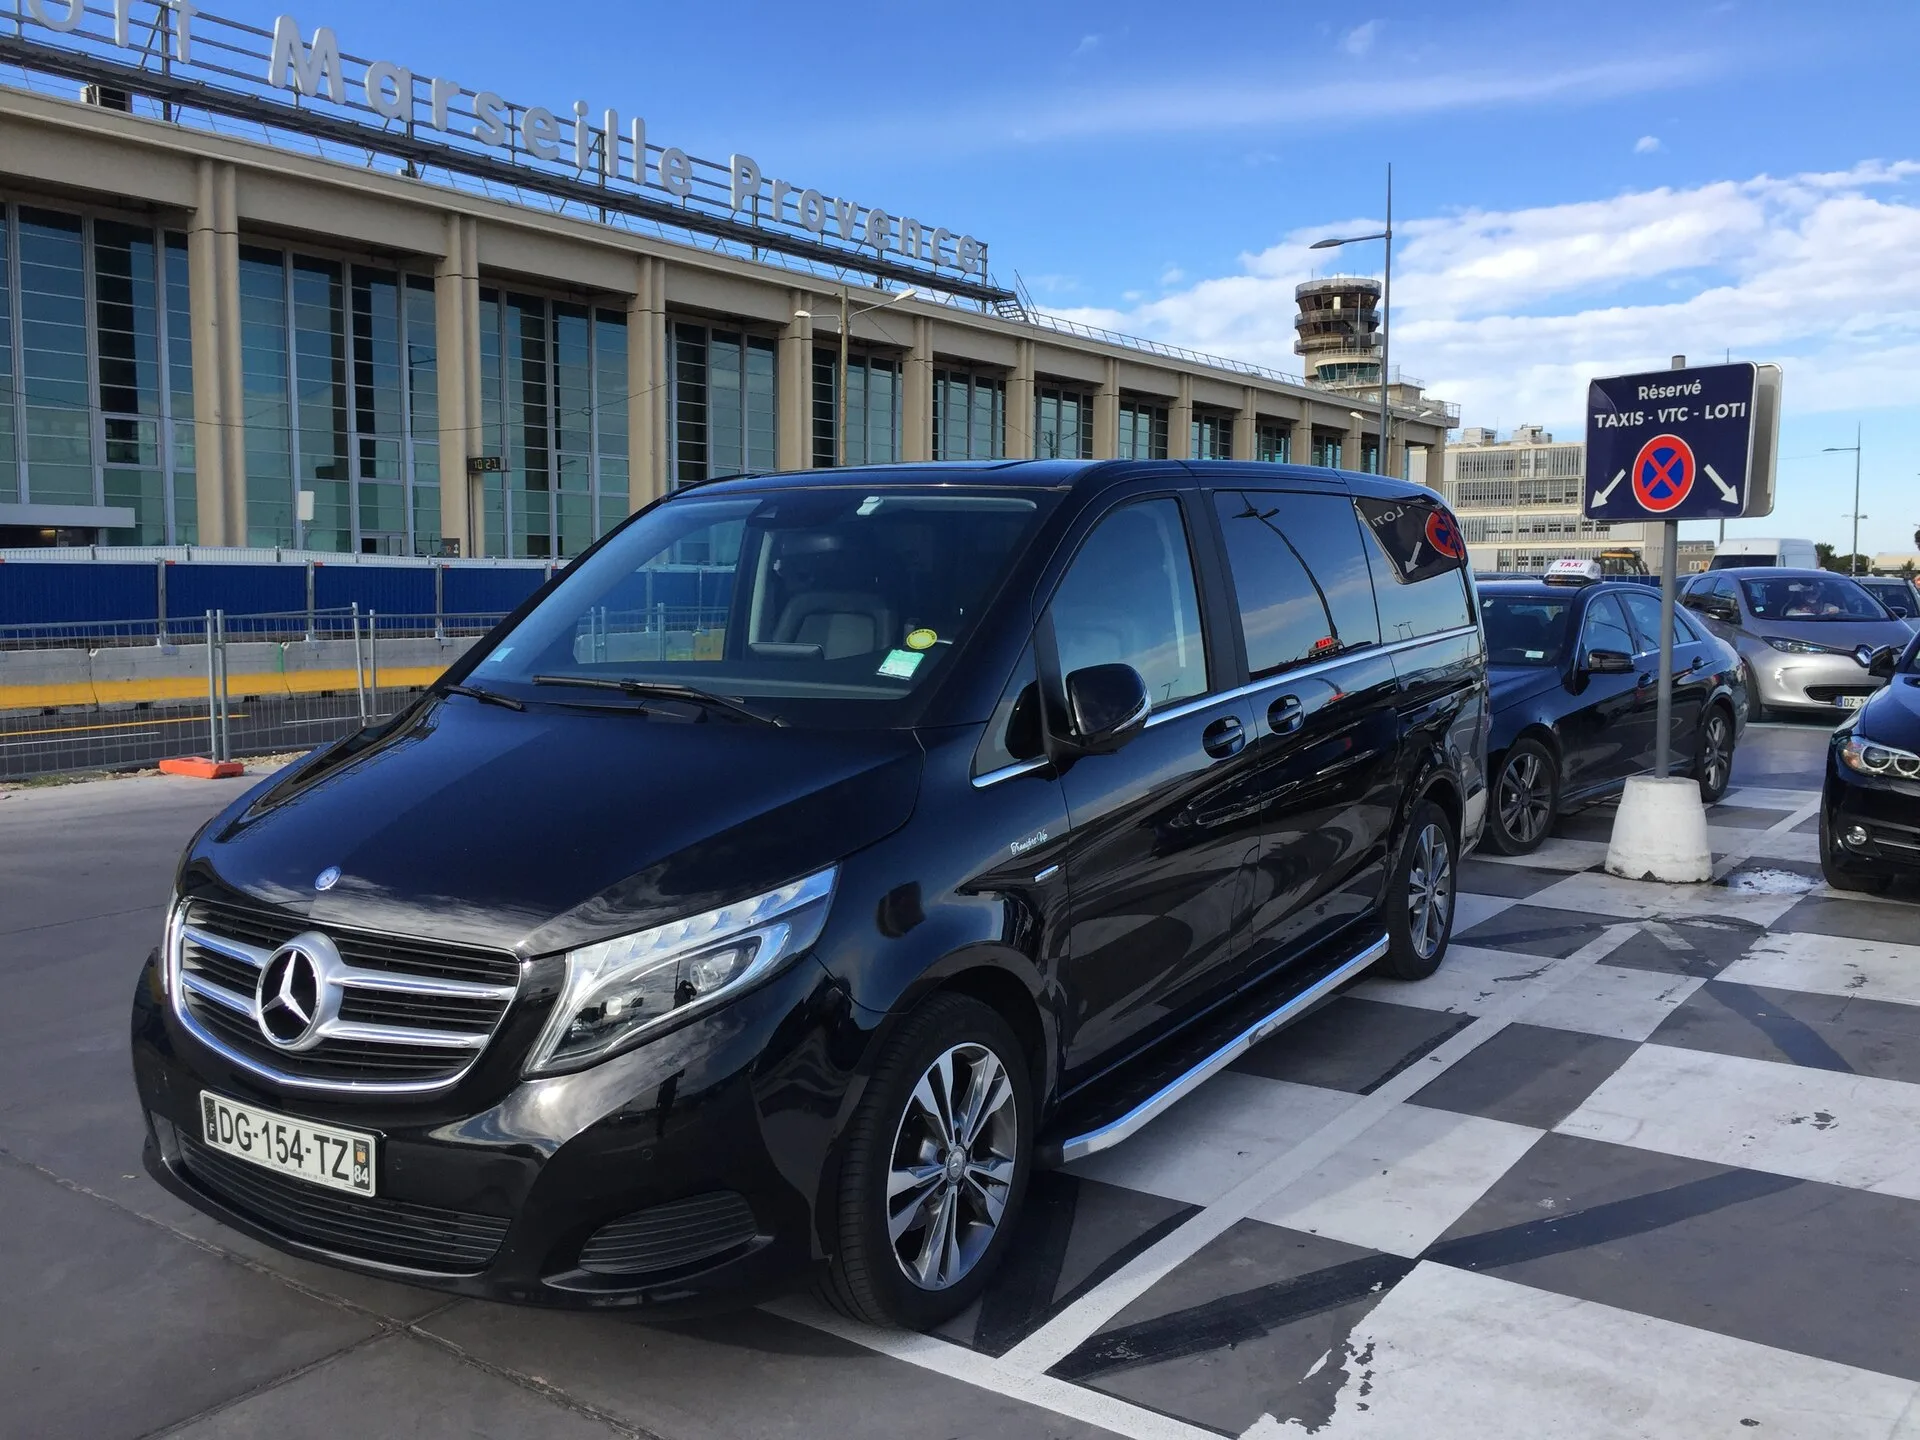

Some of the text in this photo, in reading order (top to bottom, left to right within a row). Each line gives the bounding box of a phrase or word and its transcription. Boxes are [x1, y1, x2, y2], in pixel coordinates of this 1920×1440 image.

[268, 15, 693, 197] Marseille
[730, 153, 979, 273] Provence
[1638, 379, 1702, 401] Réservé
[1594, 411, 1644, 428] TAXIS
[1657, 407, 1689, 424] VTC
[1704, 402, 1746, 420] LOTI
[218, 1105, 350, 1182] DG-154-TZ
[354, 1164, 370, 1185] 84
